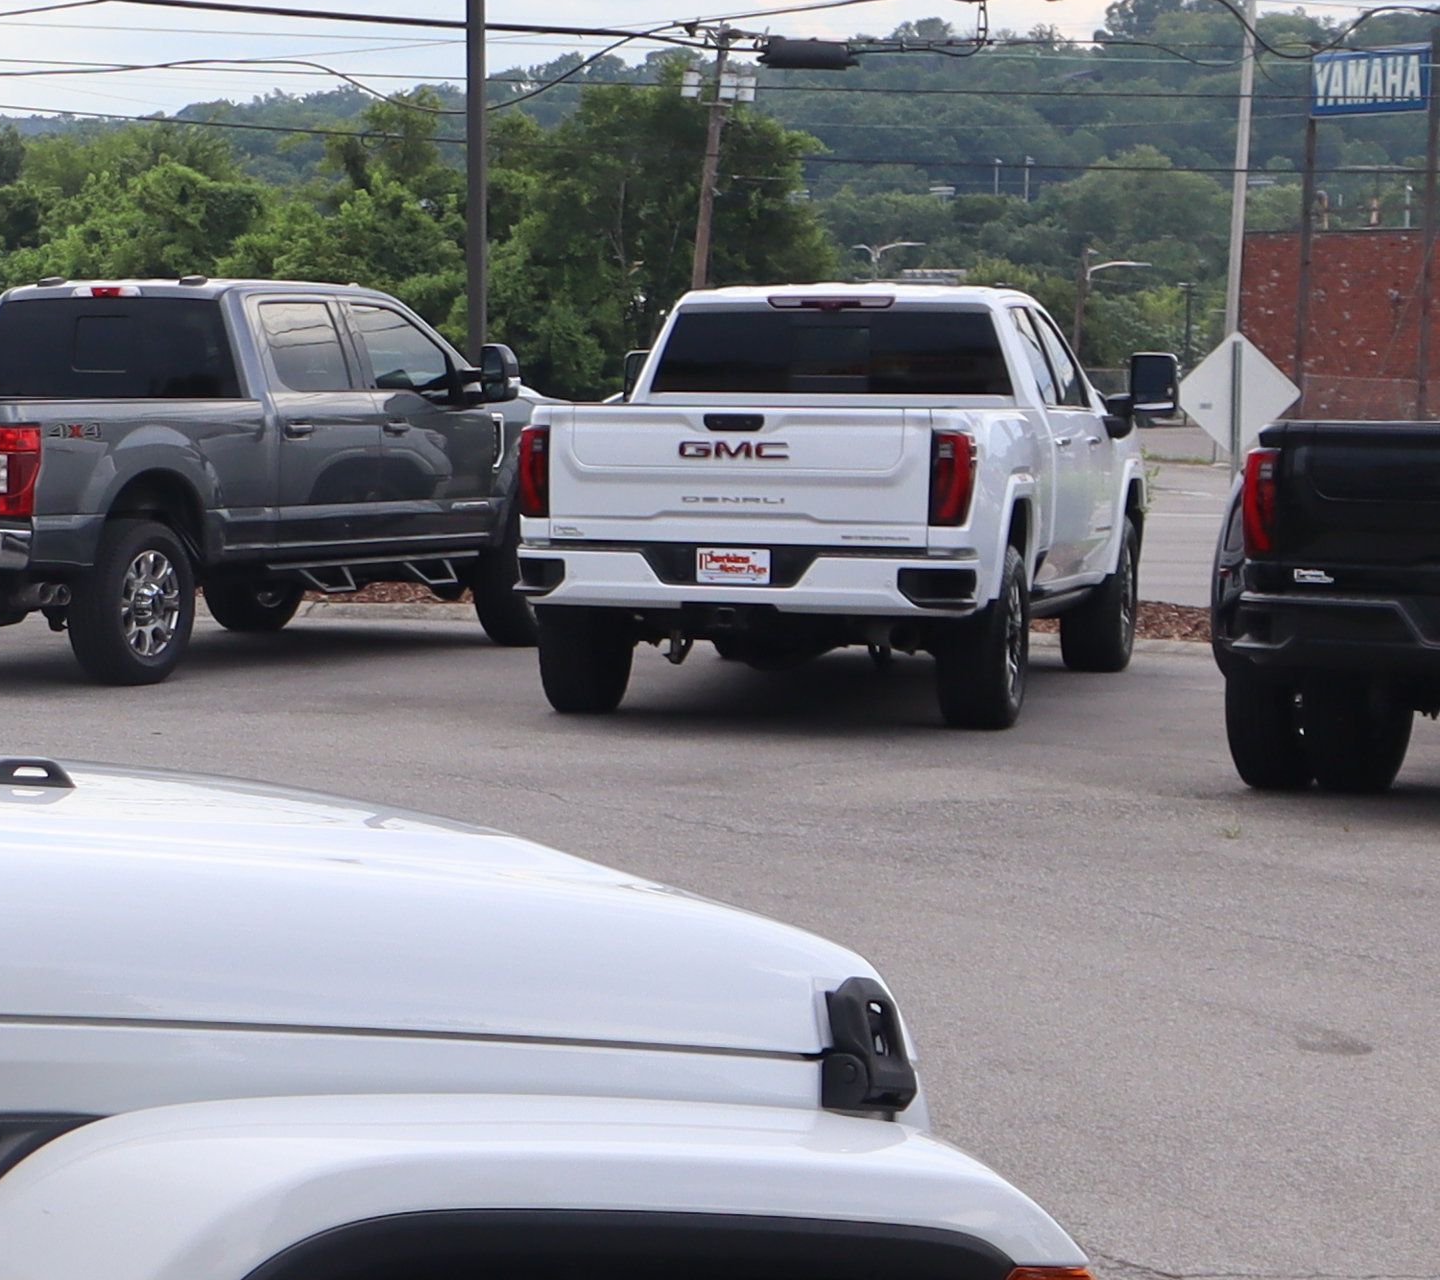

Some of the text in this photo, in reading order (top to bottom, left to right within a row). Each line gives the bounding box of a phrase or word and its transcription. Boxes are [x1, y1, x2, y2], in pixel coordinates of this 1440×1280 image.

[1314, 54, 1421, 107] YAMAHA
[678, 440, 790, 460] GMC
[681, 495, 785, 504] DENALI
